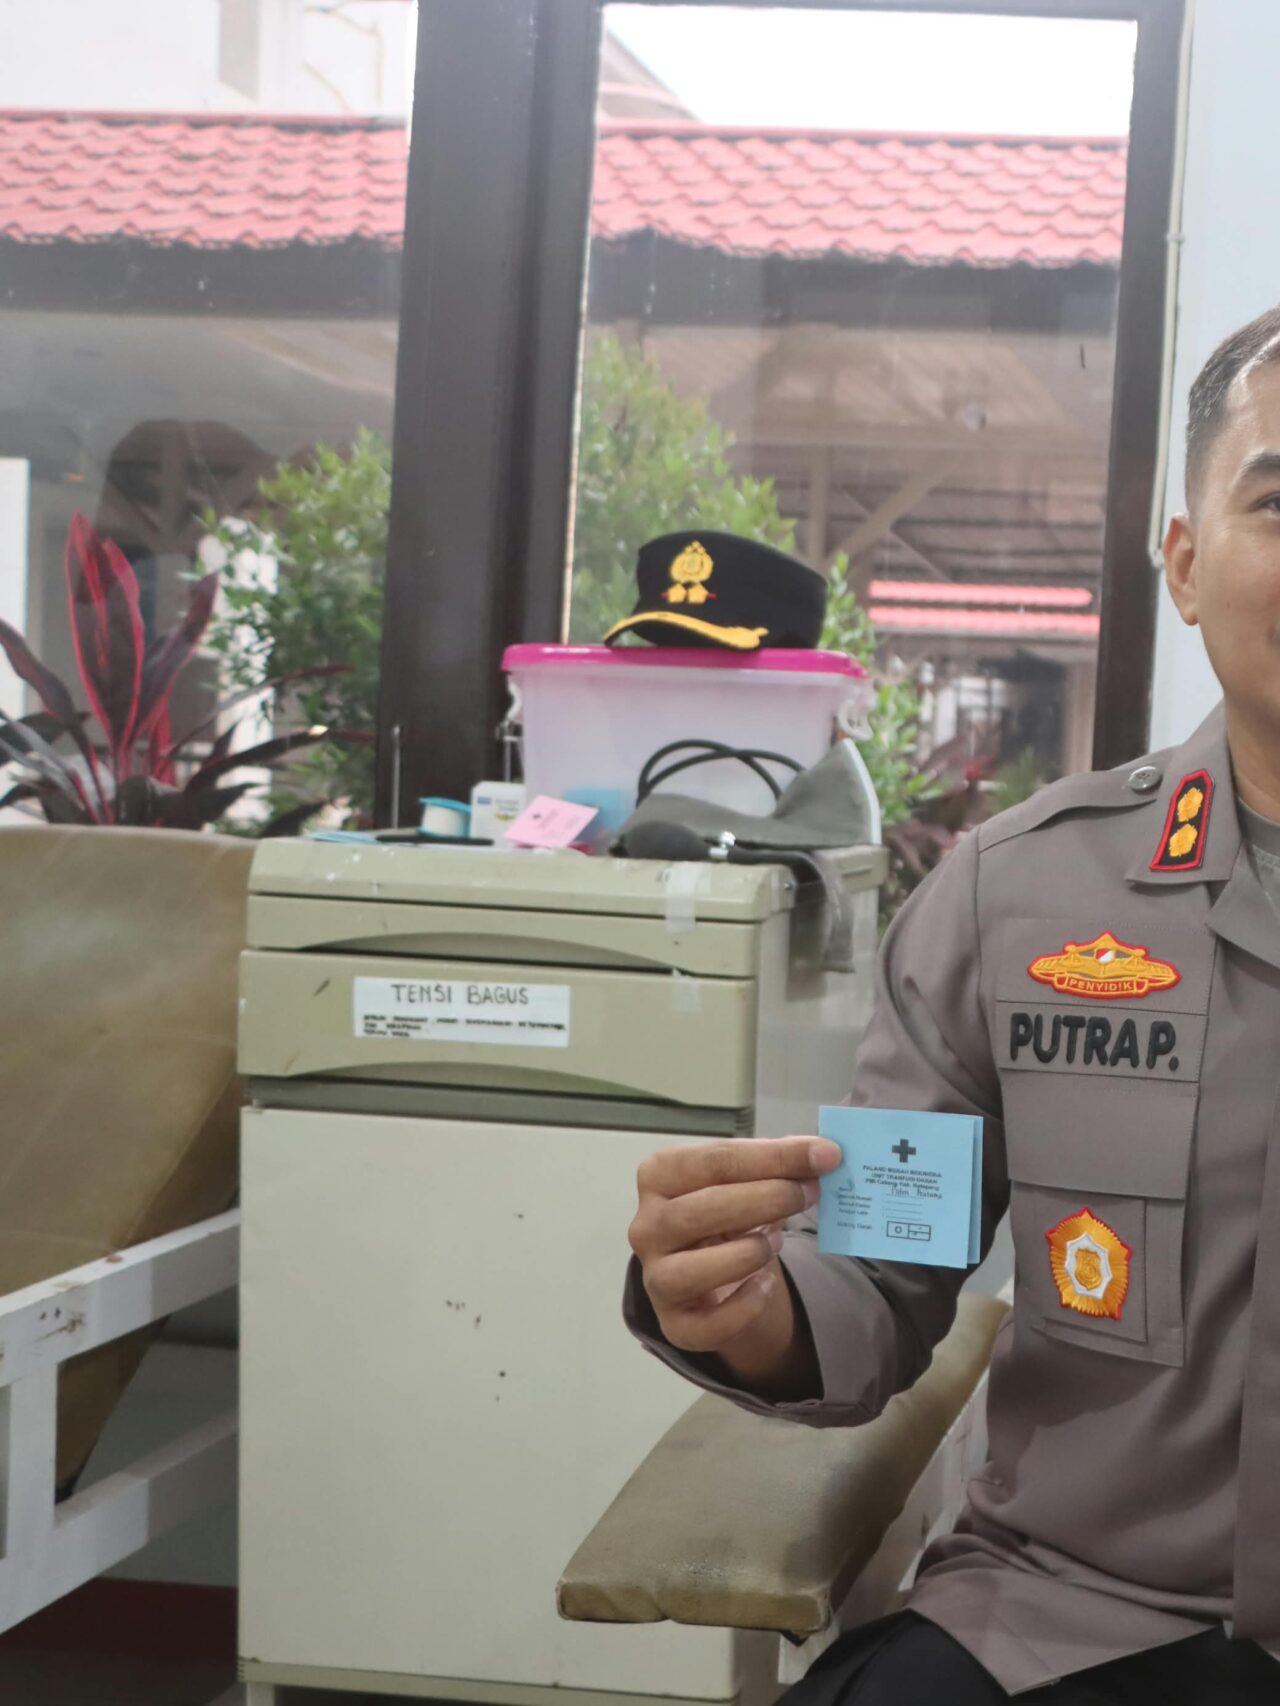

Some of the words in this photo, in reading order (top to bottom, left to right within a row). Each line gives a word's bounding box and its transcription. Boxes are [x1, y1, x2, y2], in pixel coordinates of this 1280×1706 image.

[391, 983, 453, 1003] TENSI
[467, 984, 529, 1006] BAGUS
[1069, 978, 1133, 993] PENYIDIK
[1009, 1012, 1139, 1068] PUTRA
[1146, 1020, 1179, 1072] P.
